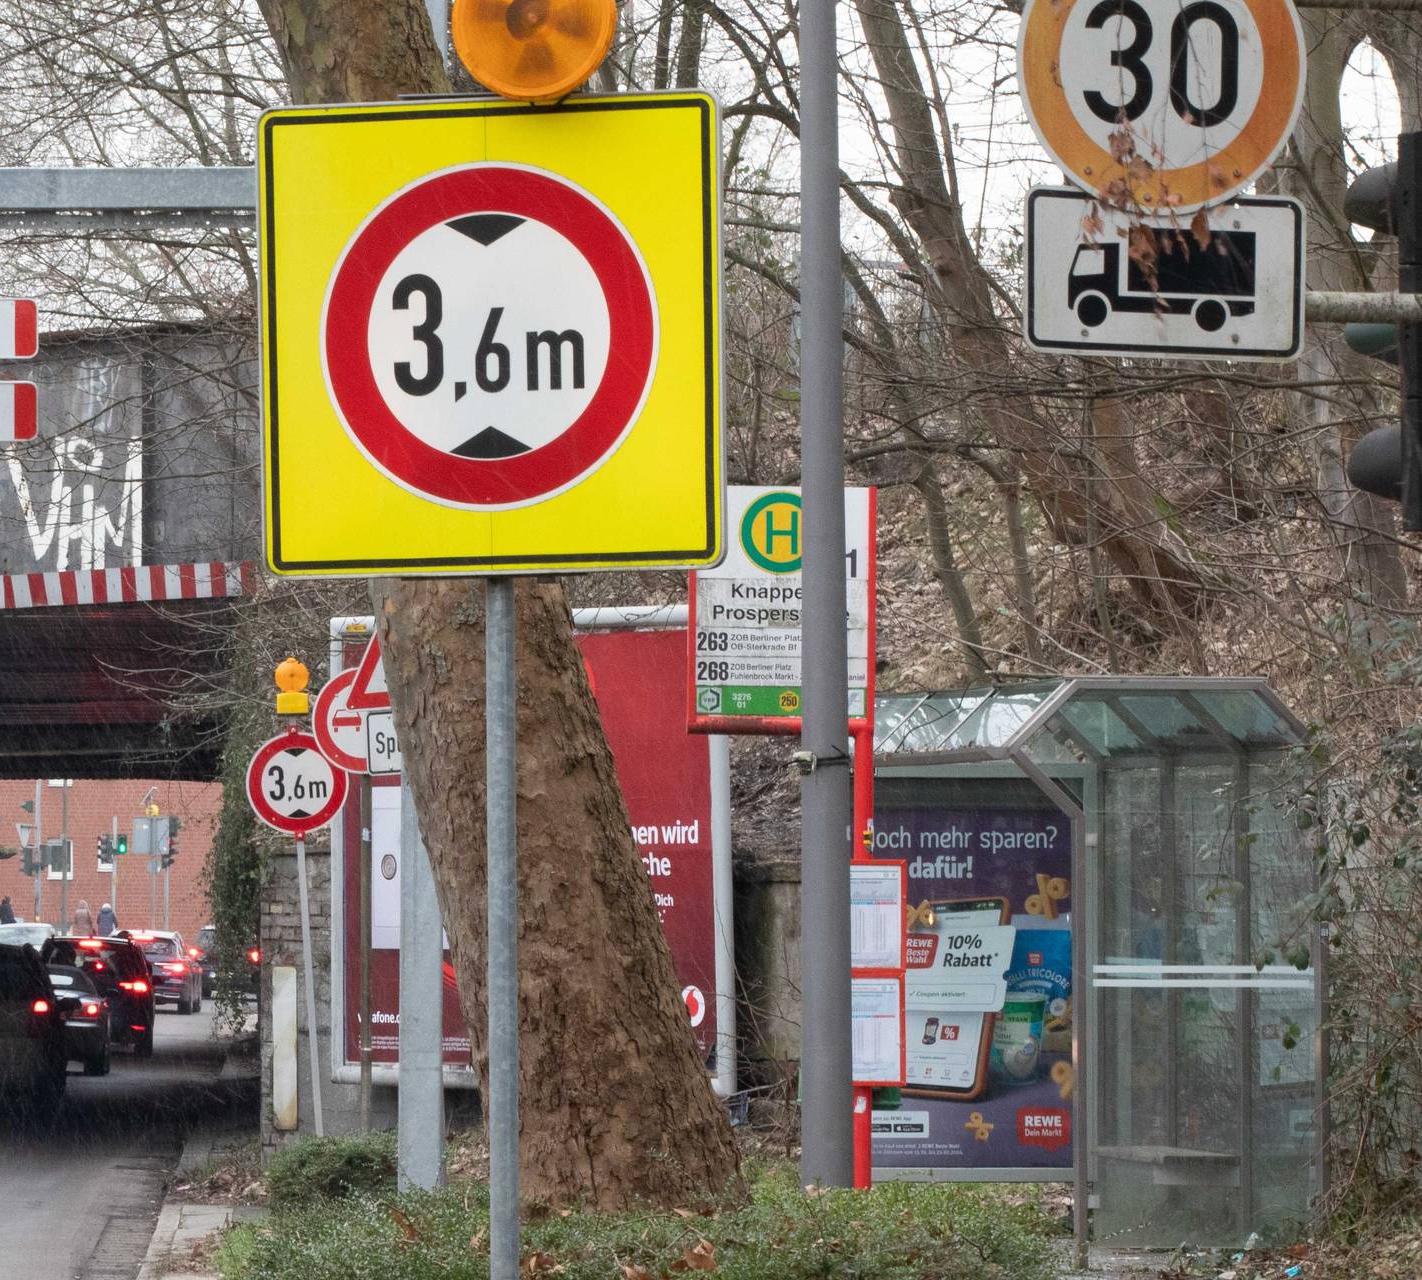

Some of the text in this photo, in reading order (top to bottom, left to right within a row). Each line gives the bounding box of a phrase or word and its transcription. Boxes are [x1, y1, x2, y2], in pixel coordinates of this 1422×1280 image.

[1082, 0, 1240, 128] 30
[765, 510, 799, 555] H
[712, 604, 850, 625] Prospers
[696, 631, 729, 652] 263
[730, 633, 749, 642] ZOB
[750, 633, 782, 642] Berliner
[730, 642, 798, 651] OB-Sterkrade Bf
[696, 661, 730, 681] 268
[730, 663, 792, 671] ZOB Berliner Platz
[730, 672, 773, 680] Fuhlenbrock
[774, 673, 794, 681] Markt
[848, 673, 866, 682] aniel
[736, 701, 746, 709] 01
[781, 695, 798, 707] 250
[661, 819, 699, 844] wird
[919, 825, 973, 849] mehr
[979, 825, 1058, 855] sparen?
[907, 855, 974, 880] dafür!
[654, 893, 674, 907] Dich
[906, 938, 934, 948] REWE
[947, 934, 983, 950] 10%
[906, 948, 930, 957] Beste
[1024, 1114, 1062, 1127] REWE
[1024, 1128, 1062, 1137] Dein Markt
